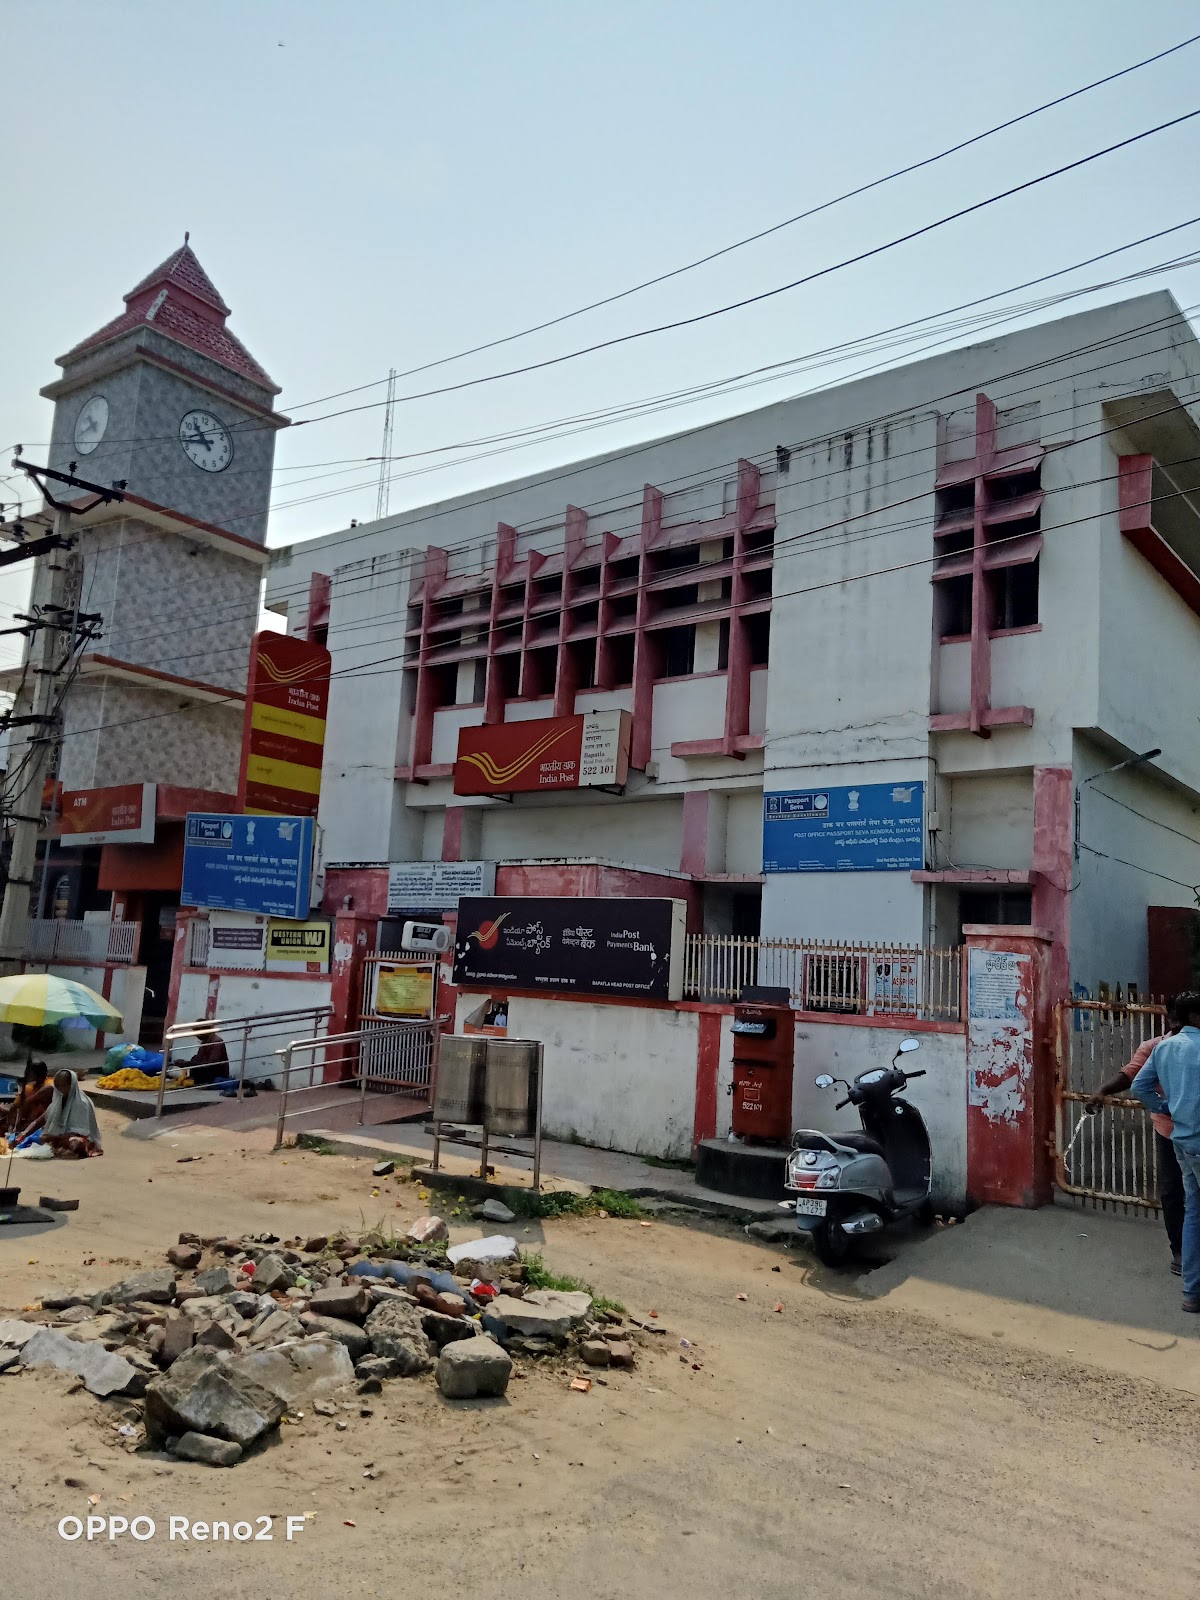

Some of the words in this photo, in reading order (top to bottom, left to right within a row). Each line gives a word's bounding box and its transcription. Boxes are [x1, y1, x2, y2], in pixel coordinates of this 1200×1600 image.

[202, 416, 209, 425] 12
[185, 422, 192, 431] 10
[219, 432, 225, 441] 2
[185, 442, 190, 451] 8
[223, 445, 228, 453] 3
[193, 452, 198, 460] 7
[219, 455, 224, 463] 4
[202, 459, 207, 468] 6
[212, 460, 217, 468] 5
[288, 695, 306, 708] India
[306, 700, 320, 711] Post
[540, 760, 562, 772] भारतीय
[563, 760, 576, 770] डाक
[582, 766, 598, 776] 522
[599, 764, 615, 775] 101
[539, 773, 558, 784] India
[559, 772, 575, 782] Post
[73, 797, 87, 807] ATM
[784, 796, 810, 805] Passport
[790, 803, 804, 811] Seva
[273, 930, 302, 938] WESTERN
[503, 926, 525, 935] ఇండియా
[576, 925, 594, 937] पोस्ट
[623, 929, 640, 939] Post
[280, 937, 301, 945] UNION
[527, 935, 552, 955] బ్యాంక్
[580, 935, 597, 949] बैंक
[606, 940, 633, 949] Payments
[633, 941, 655, 952] Bank
[742, 1101, 763, 1112] 522101
